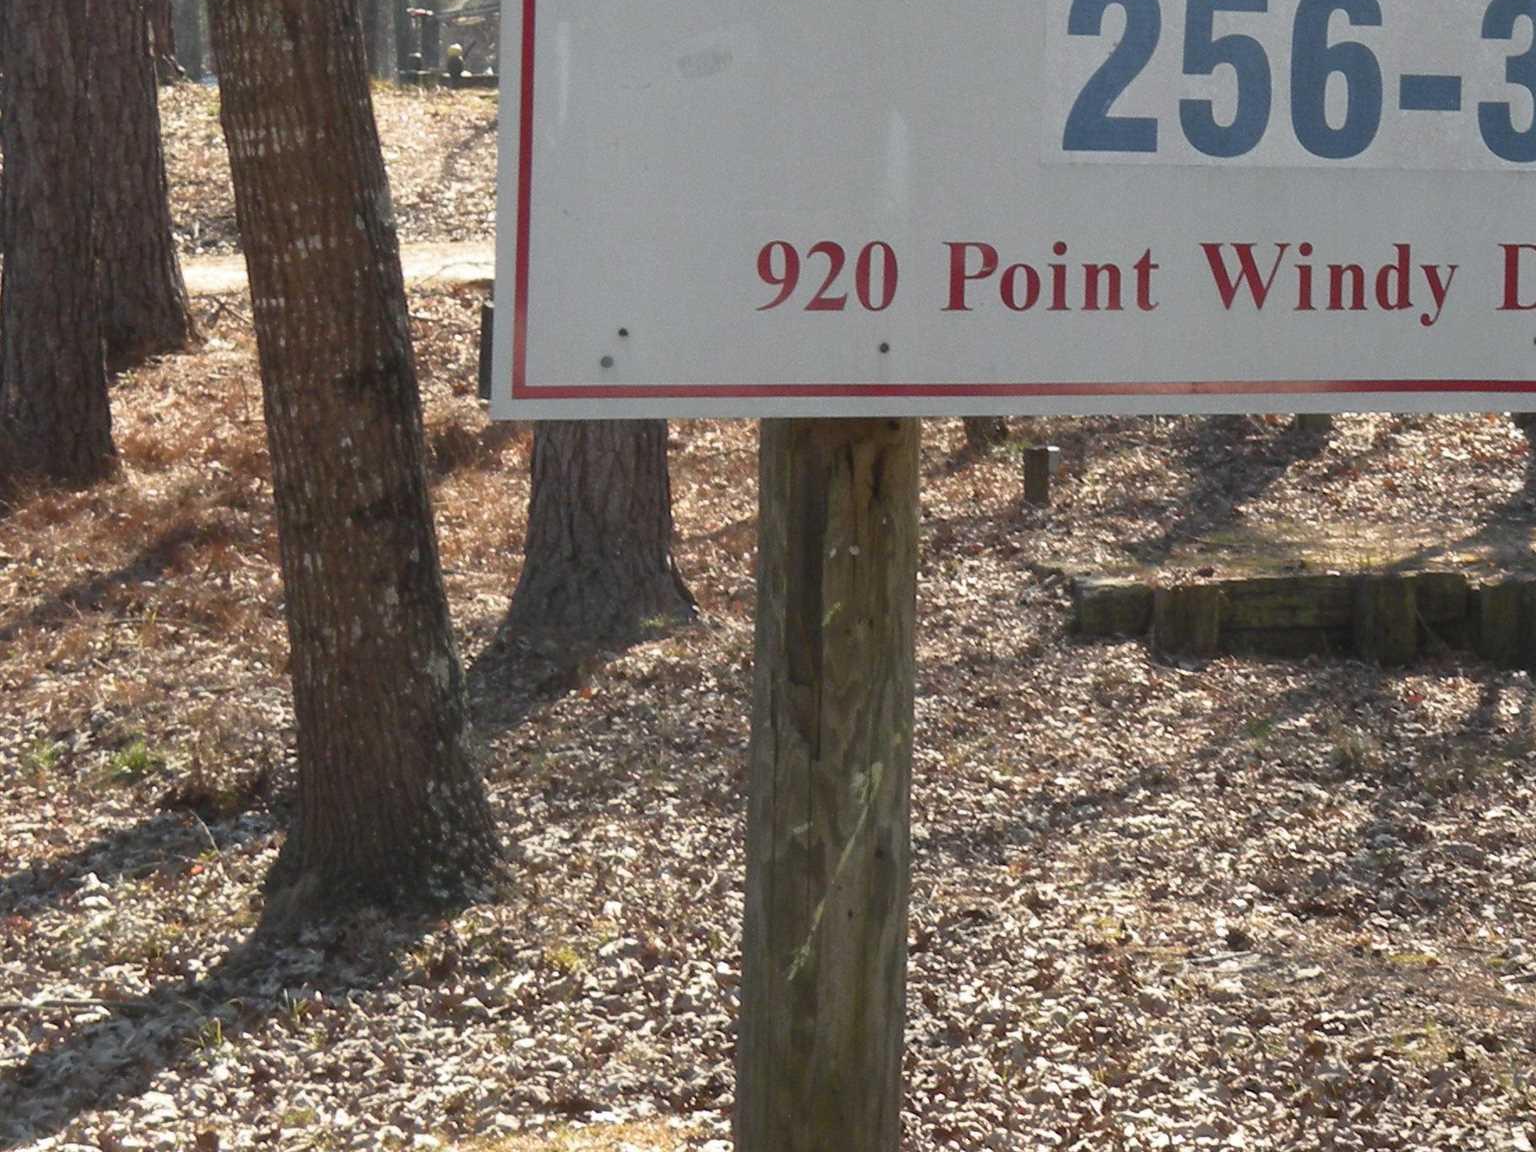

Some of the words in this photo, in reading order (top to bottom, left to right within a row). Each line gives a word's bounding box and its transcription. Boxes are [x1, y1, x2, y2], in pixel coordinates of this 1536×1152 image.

[756, 241, 898, 311] 920
[940, 241, 1159, 313] Point
[1198, 242, 1459, 326] Windy
